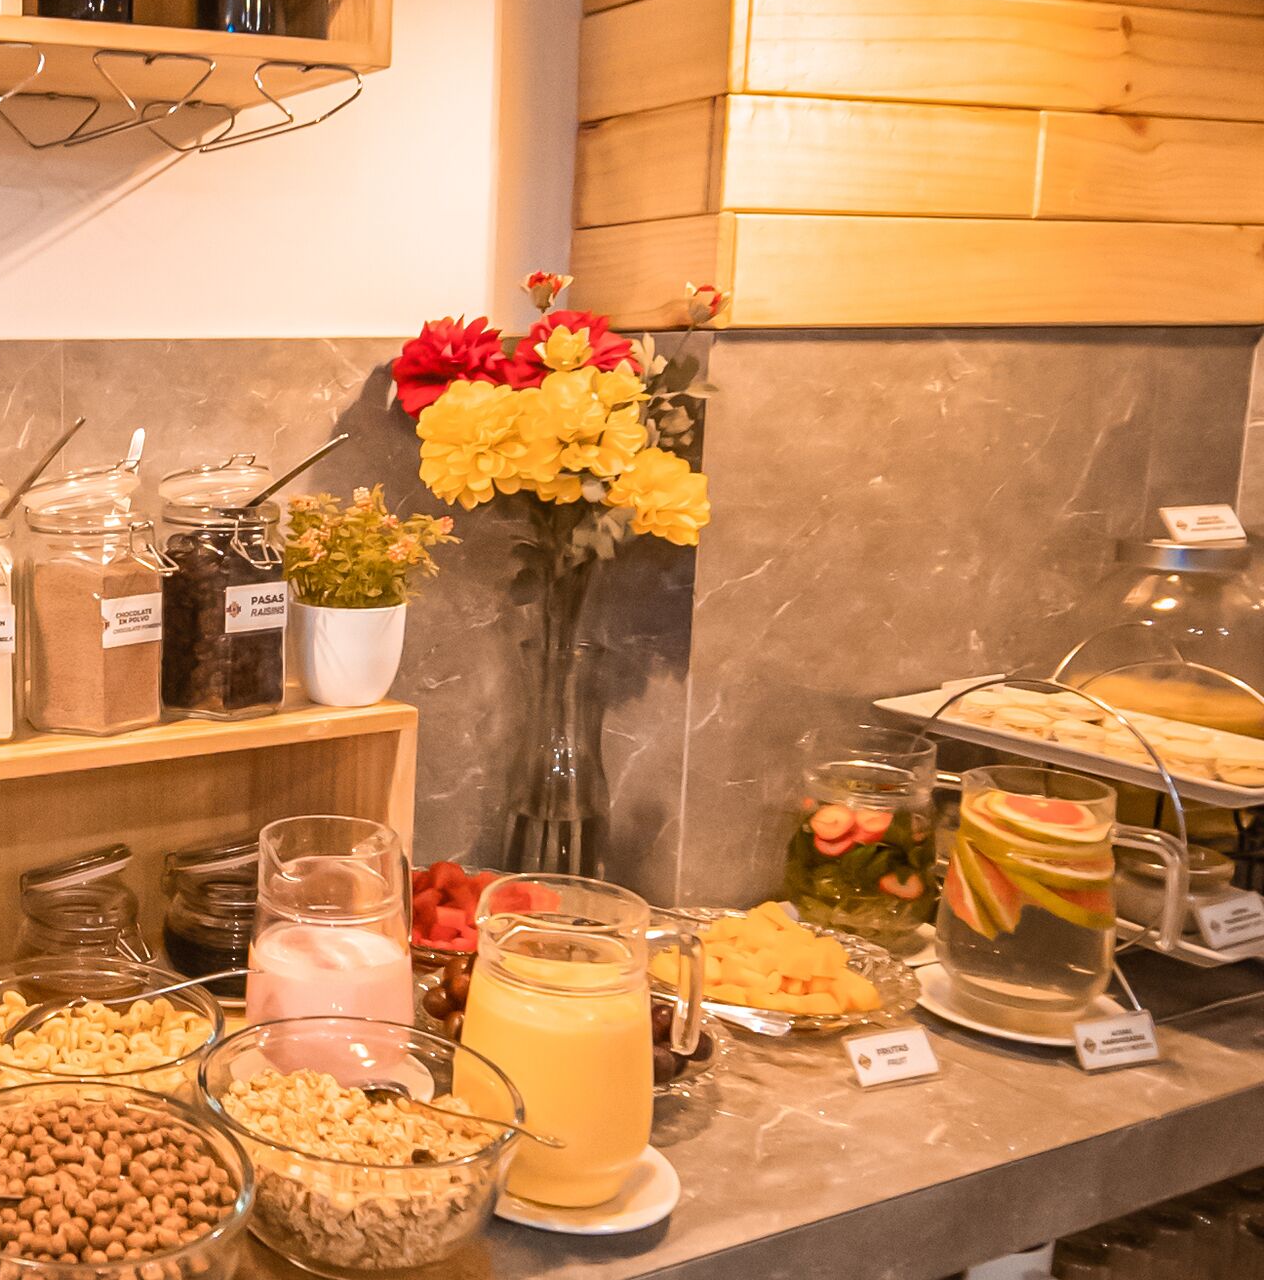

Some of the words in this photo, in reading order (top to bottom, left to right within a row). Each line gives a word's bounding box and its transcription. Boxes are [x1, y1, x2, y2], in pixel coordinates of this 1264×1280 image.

[251, 593, 285, 606] PASAS
[115, 608, 152, 619] CHOCOLATE
[250, 605, 285, 617] RAISINS
